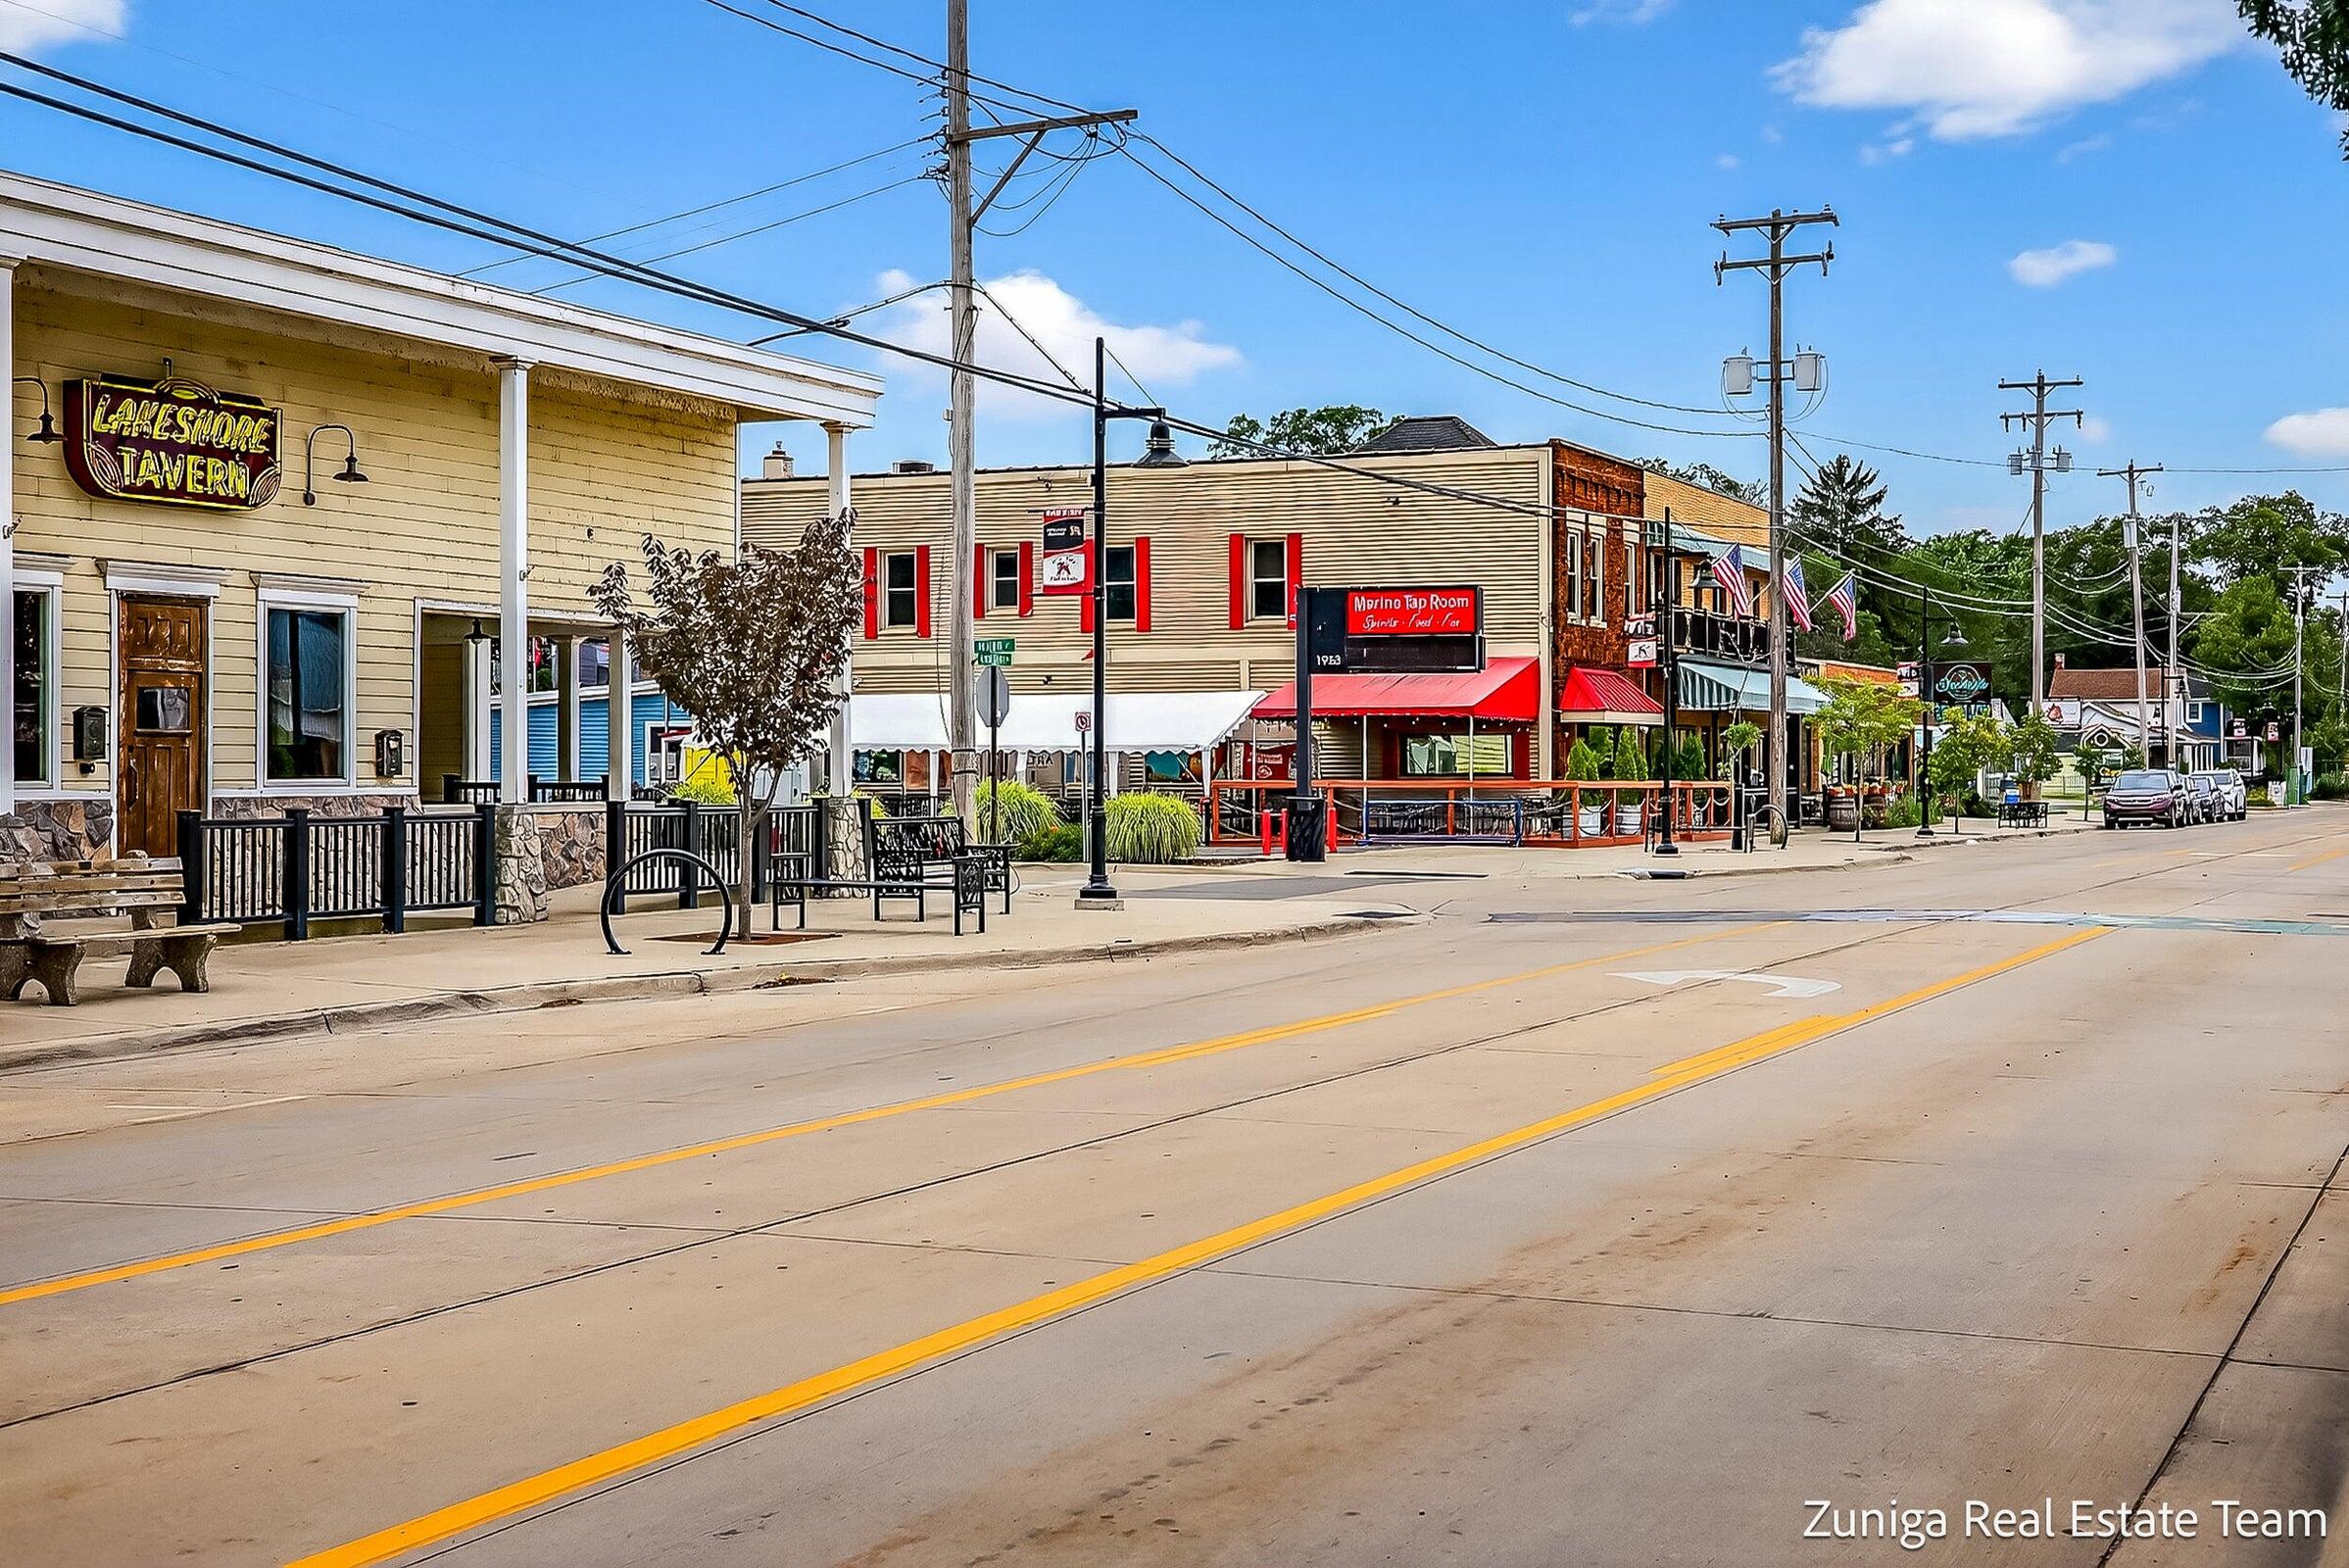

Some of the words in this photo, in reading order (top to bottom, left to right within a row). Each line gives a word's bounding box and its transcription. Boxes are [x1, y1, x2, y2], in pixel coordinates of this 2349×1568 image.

[92, 393, 274, 454] LAKESHORE
[116, 445, 252, 499] TAVERN
[1403, 595, 1427, 612] Tap
[1430, 593, 1469, 611] Room
